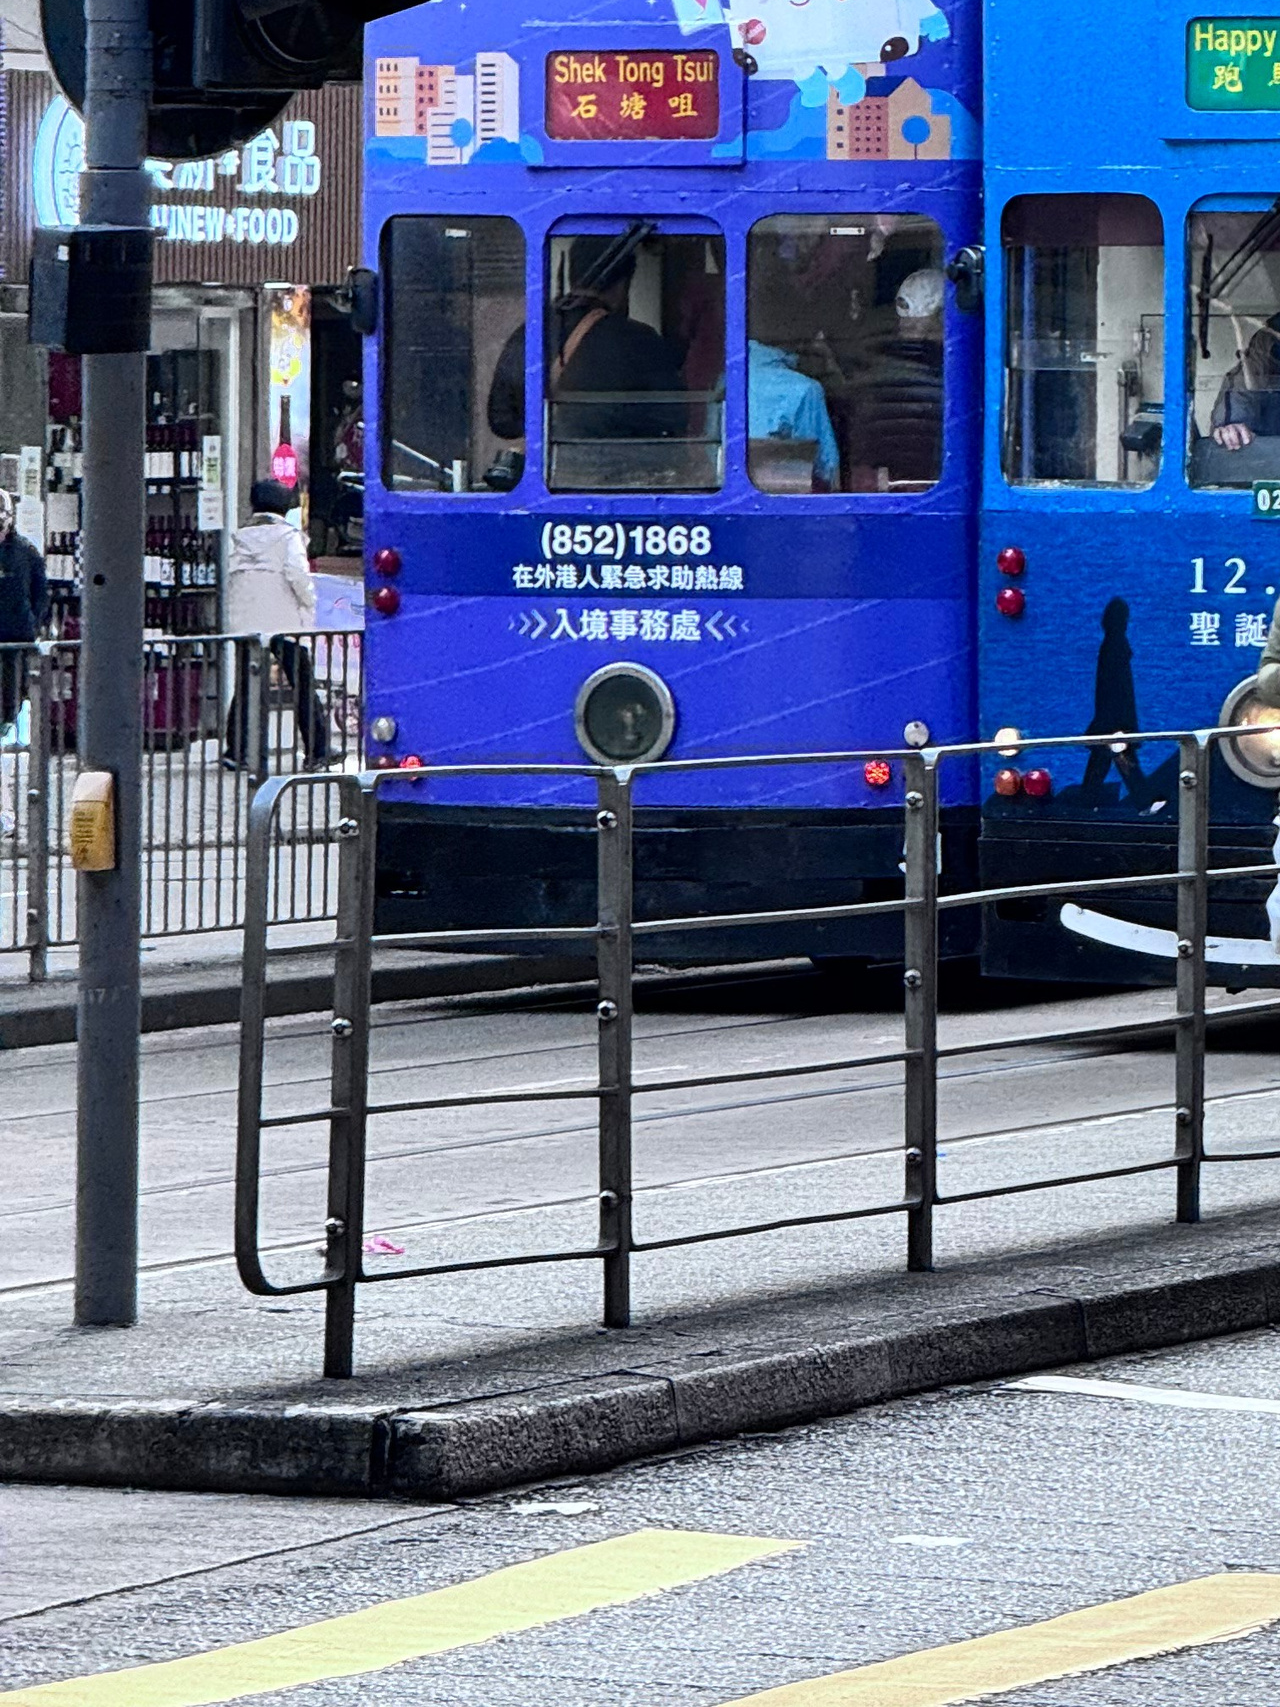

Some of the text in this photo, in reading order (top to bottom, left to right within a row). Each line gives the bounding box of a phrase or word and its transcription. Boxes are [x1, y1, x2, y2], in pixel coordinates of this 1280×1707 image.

[1194, 22, 1278, 57] Happy
[554, 54, 714, 88] Shek Tong Tsui
[570, 91, 699, 121] 石塘咀
[232, 206, 299, 243] FOOD
[541, 521, 712, 560] (852)1868
[511, 563, 744, 591] 在外港人緊急求助熱線
[550, 607, 702, 642] 入境事務處
